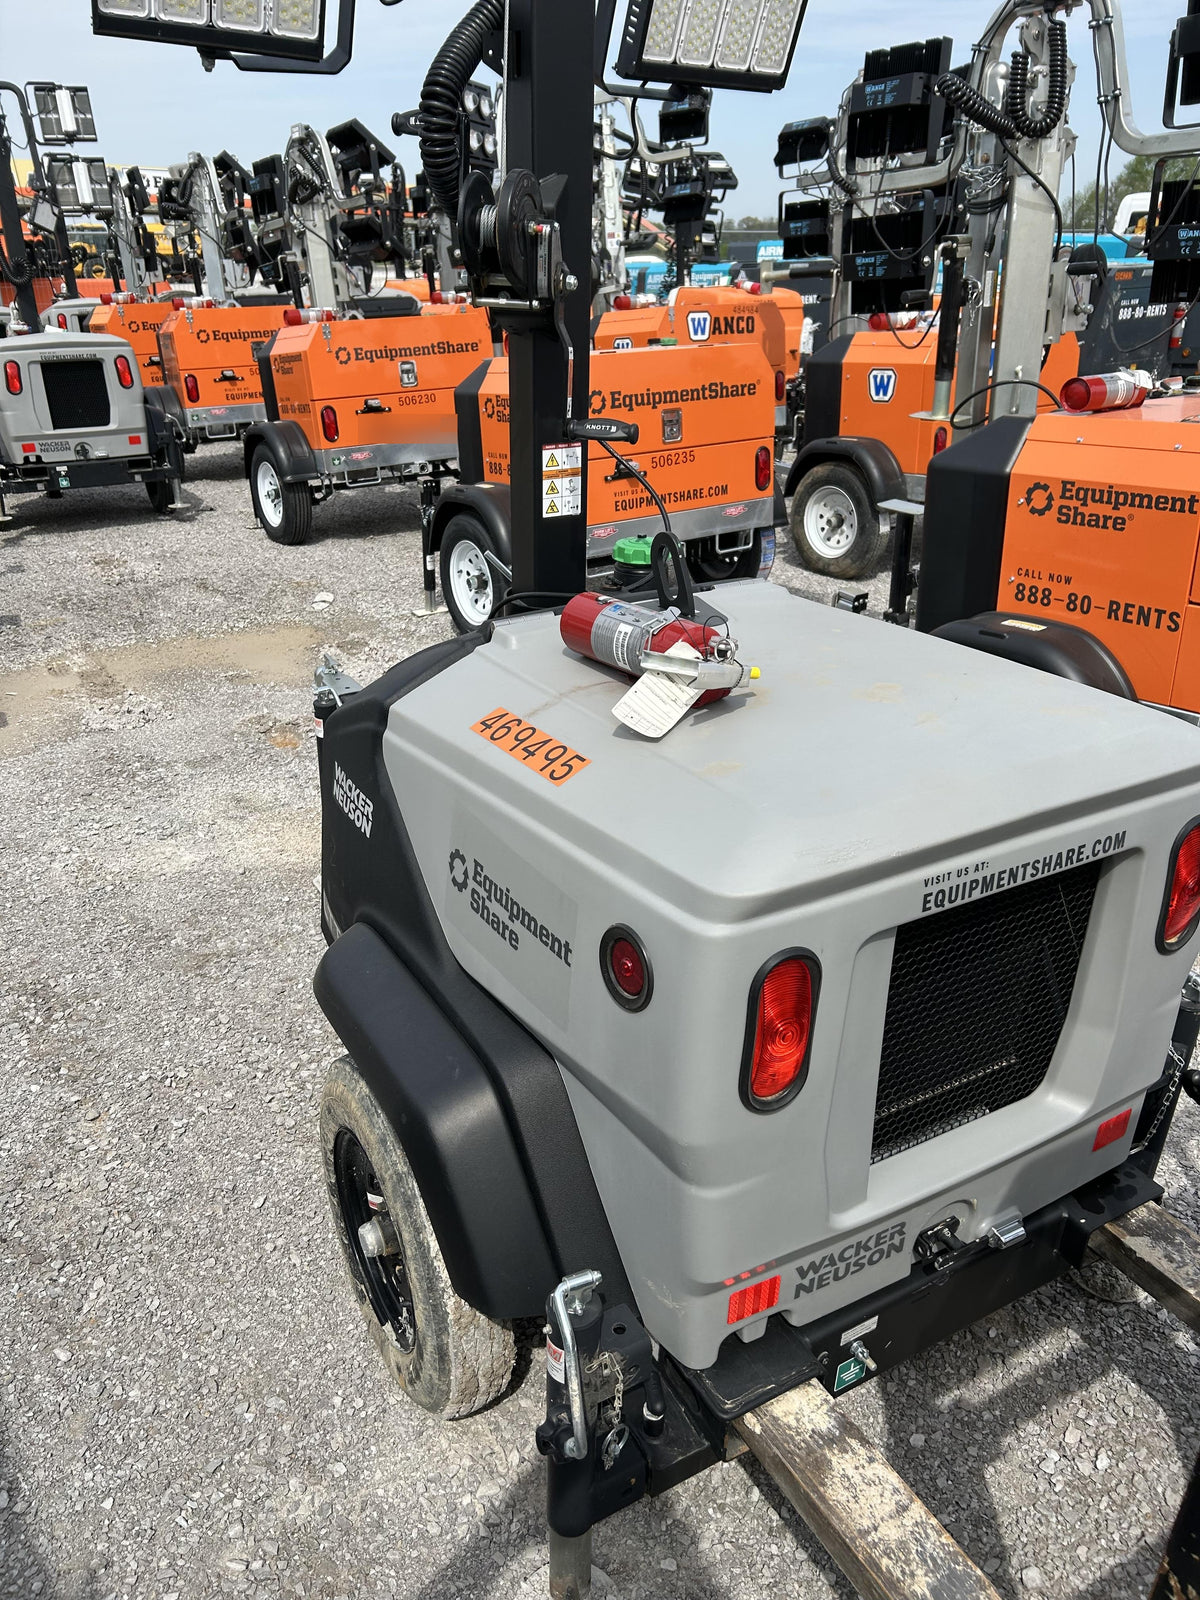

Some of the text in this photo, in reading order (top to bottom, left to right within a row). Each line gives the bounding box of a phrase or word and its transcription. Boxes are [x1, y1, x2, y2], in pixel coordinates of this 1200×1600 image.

[690, 315, 755, 337] WANCO
[1118, 304, 1168, 320] 888-80-RENTS
[212, 327, 281, 343] Equipmen
[399, 393, 437, 407] 506230
[651, 450, 696, 470] 506235
[613, 490, 629, 498] VISIT
[1059, 480, 1199, 516] Equipment
[1017, 567, 1073, 586] CALL NOW
[1014, 583, 1182, 633] 888-80-RENTS
[480, 712, 587, 781] 469495
[333, 780, 372, 838] NEUSON
[335, 761, 374, 820] WACKER
[921, 830, 1127, 913] EQUIPMENTSHARE.COM
[924, 861, 990, 887] VISIT US AT:
[470, 887, 519, 951] Share
[472, 858, 573, 968] Equipment
[794, 1237, 906, 1300] NEUSON
[796, 1222, 907, 1281] WACKER
